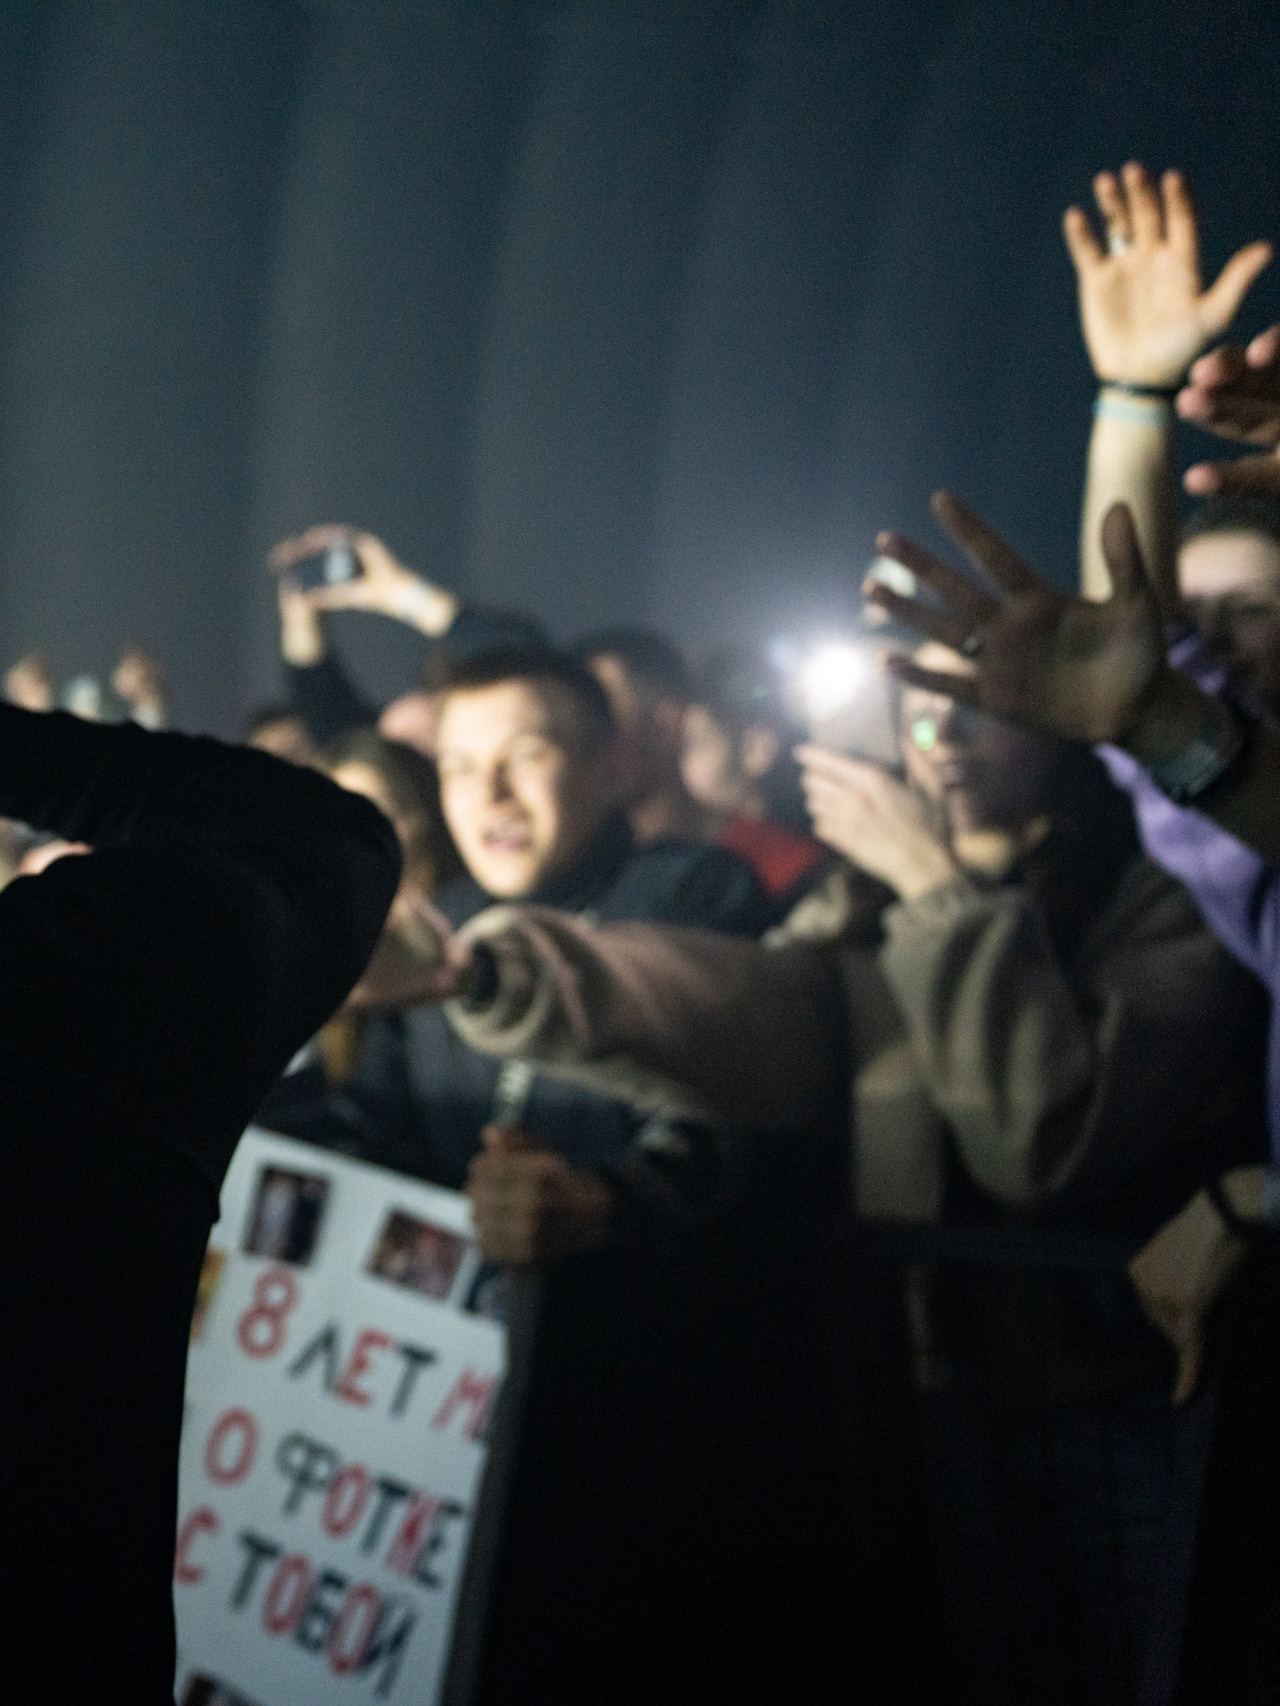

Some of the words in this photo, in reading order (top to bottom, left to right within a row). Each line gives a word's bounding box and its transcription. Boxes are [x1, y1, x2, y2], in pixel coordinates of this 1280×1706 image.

[237, 1267, 300, 1359] 8
[289, 1318, 437, 1421] ЛЕТ
[174, 1507, 218, 1586] С
[204, 1407, 260, 1487] О
[275, 1430, 464, 1590] ФОТКЕ
